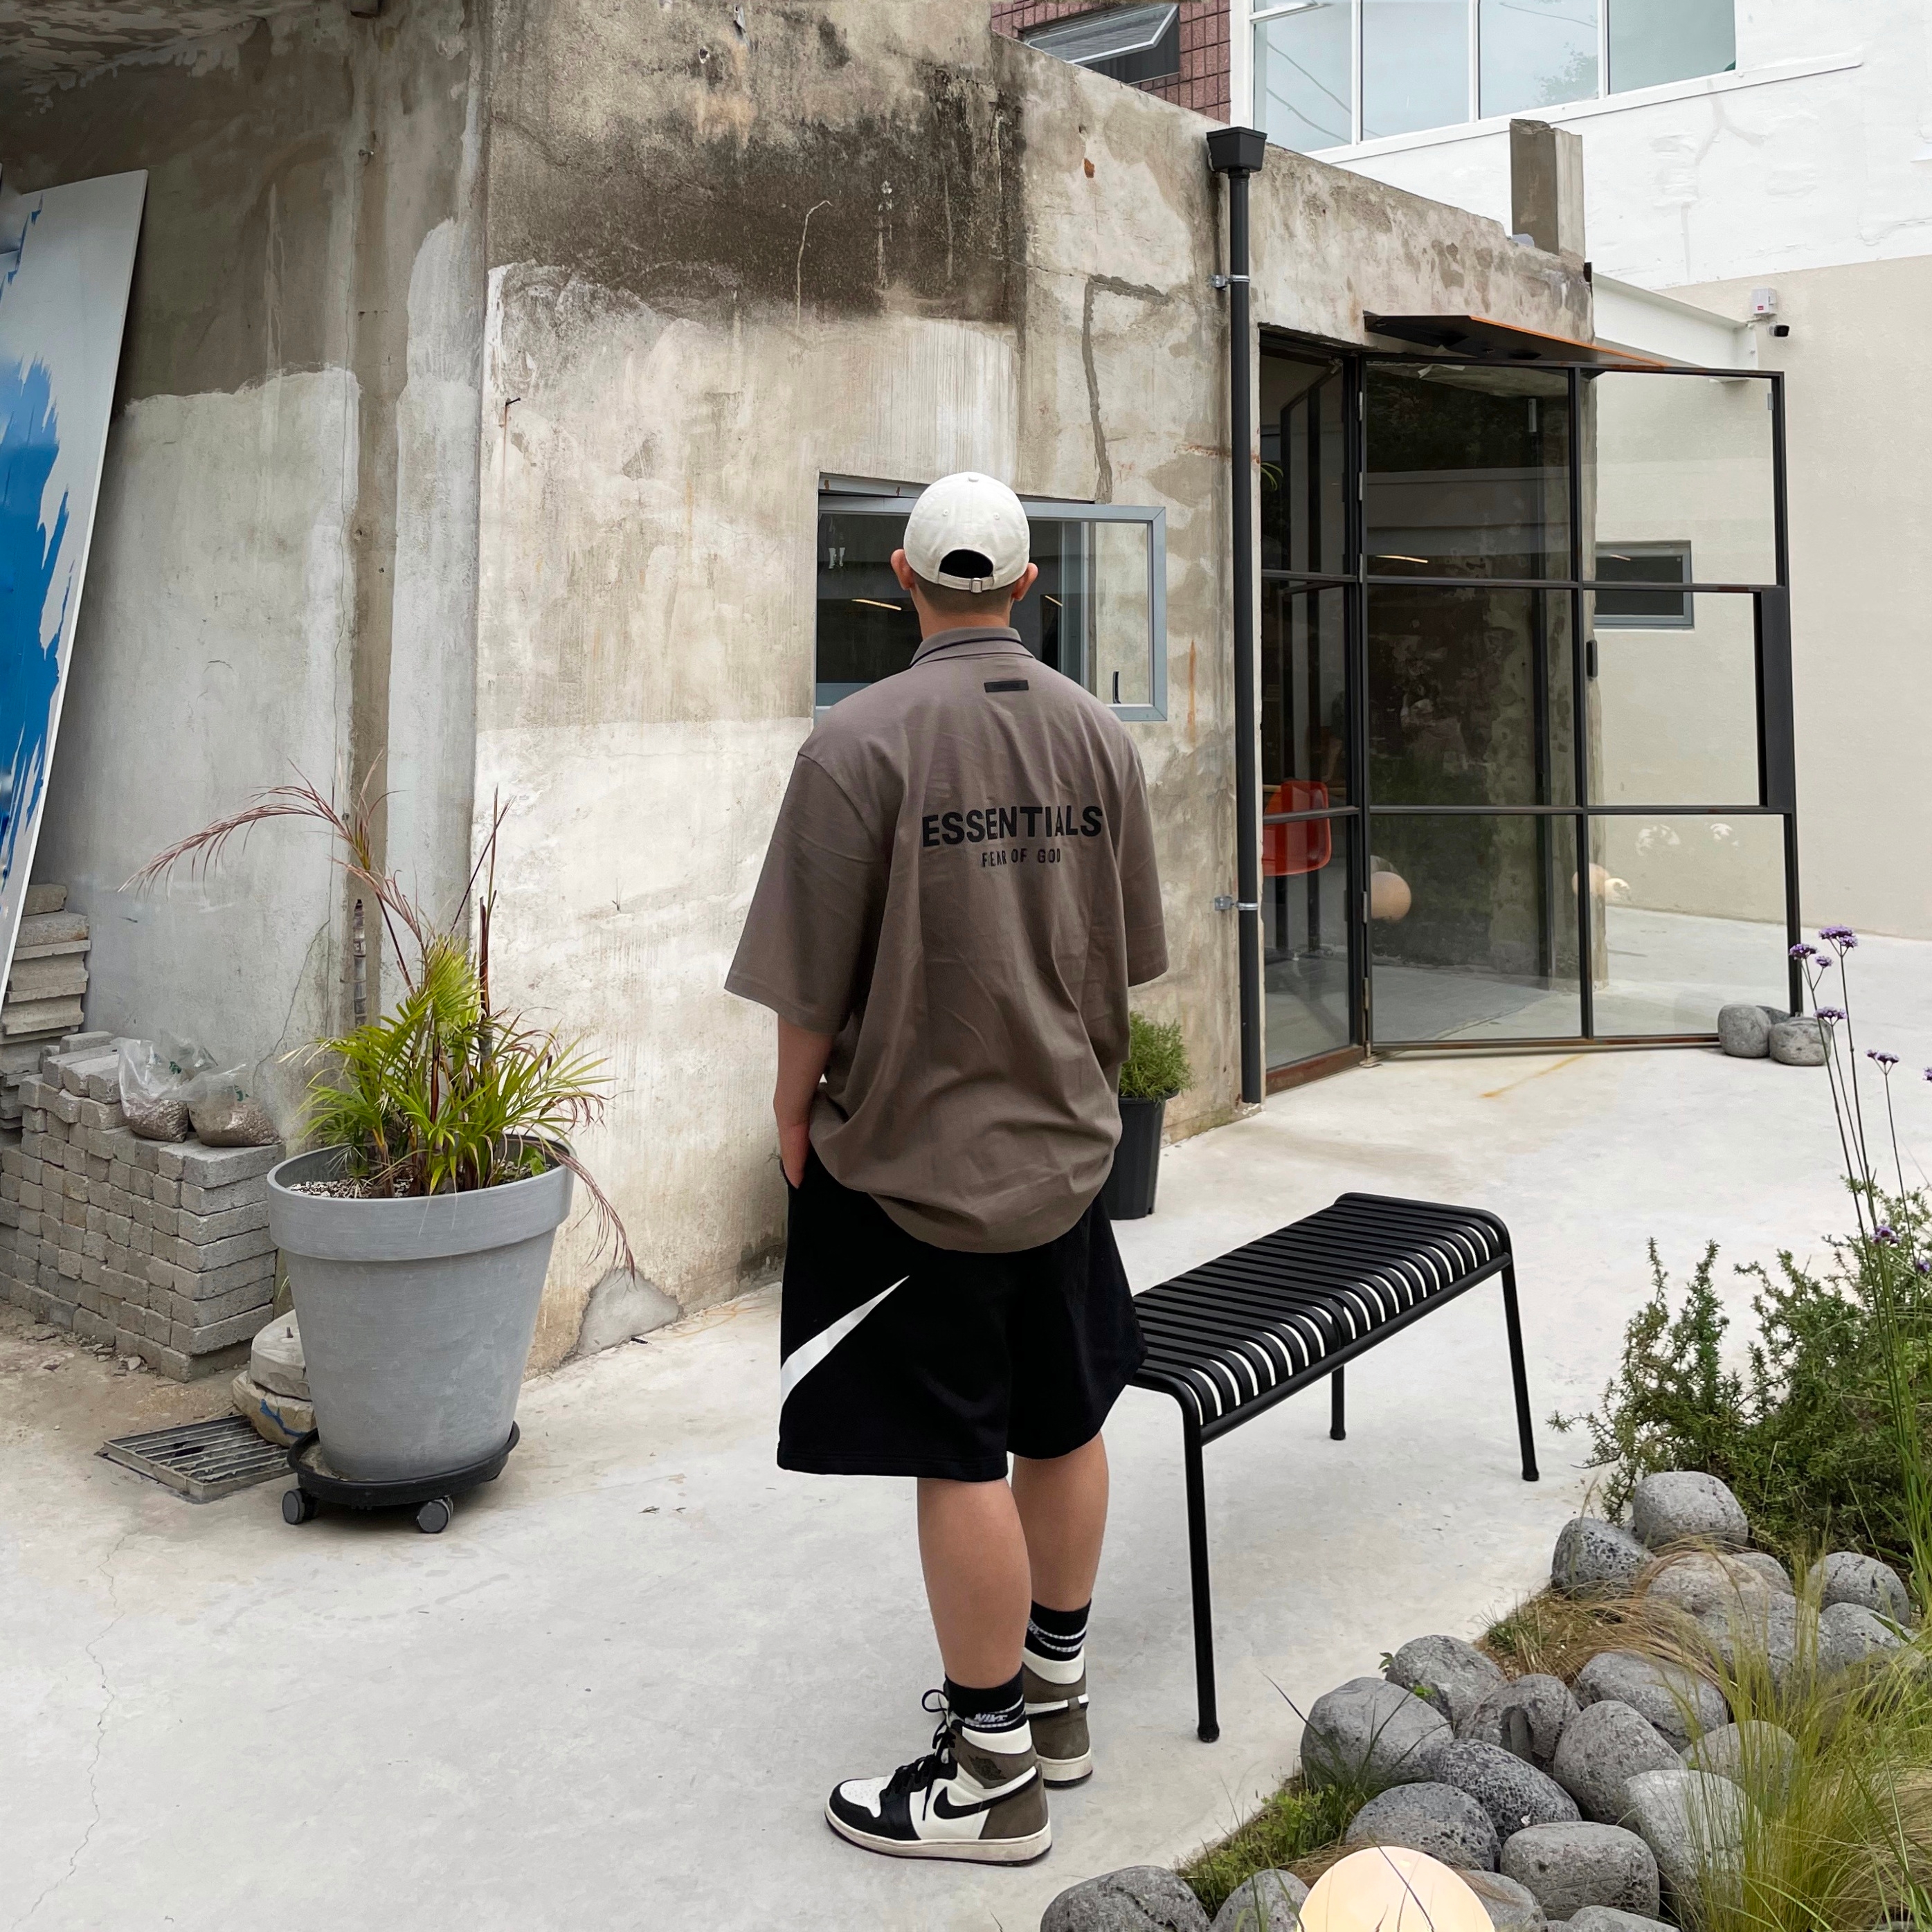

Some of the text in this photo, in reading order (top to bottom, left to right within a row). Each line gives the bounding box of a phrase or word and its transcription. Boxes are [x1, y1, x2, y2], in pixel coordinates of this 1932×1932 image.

[922, 805, 1103, 848] ESSENTIALS
[982, 850, 1007, 867] FEAR
[1011, 848, 1028, 863] OF
